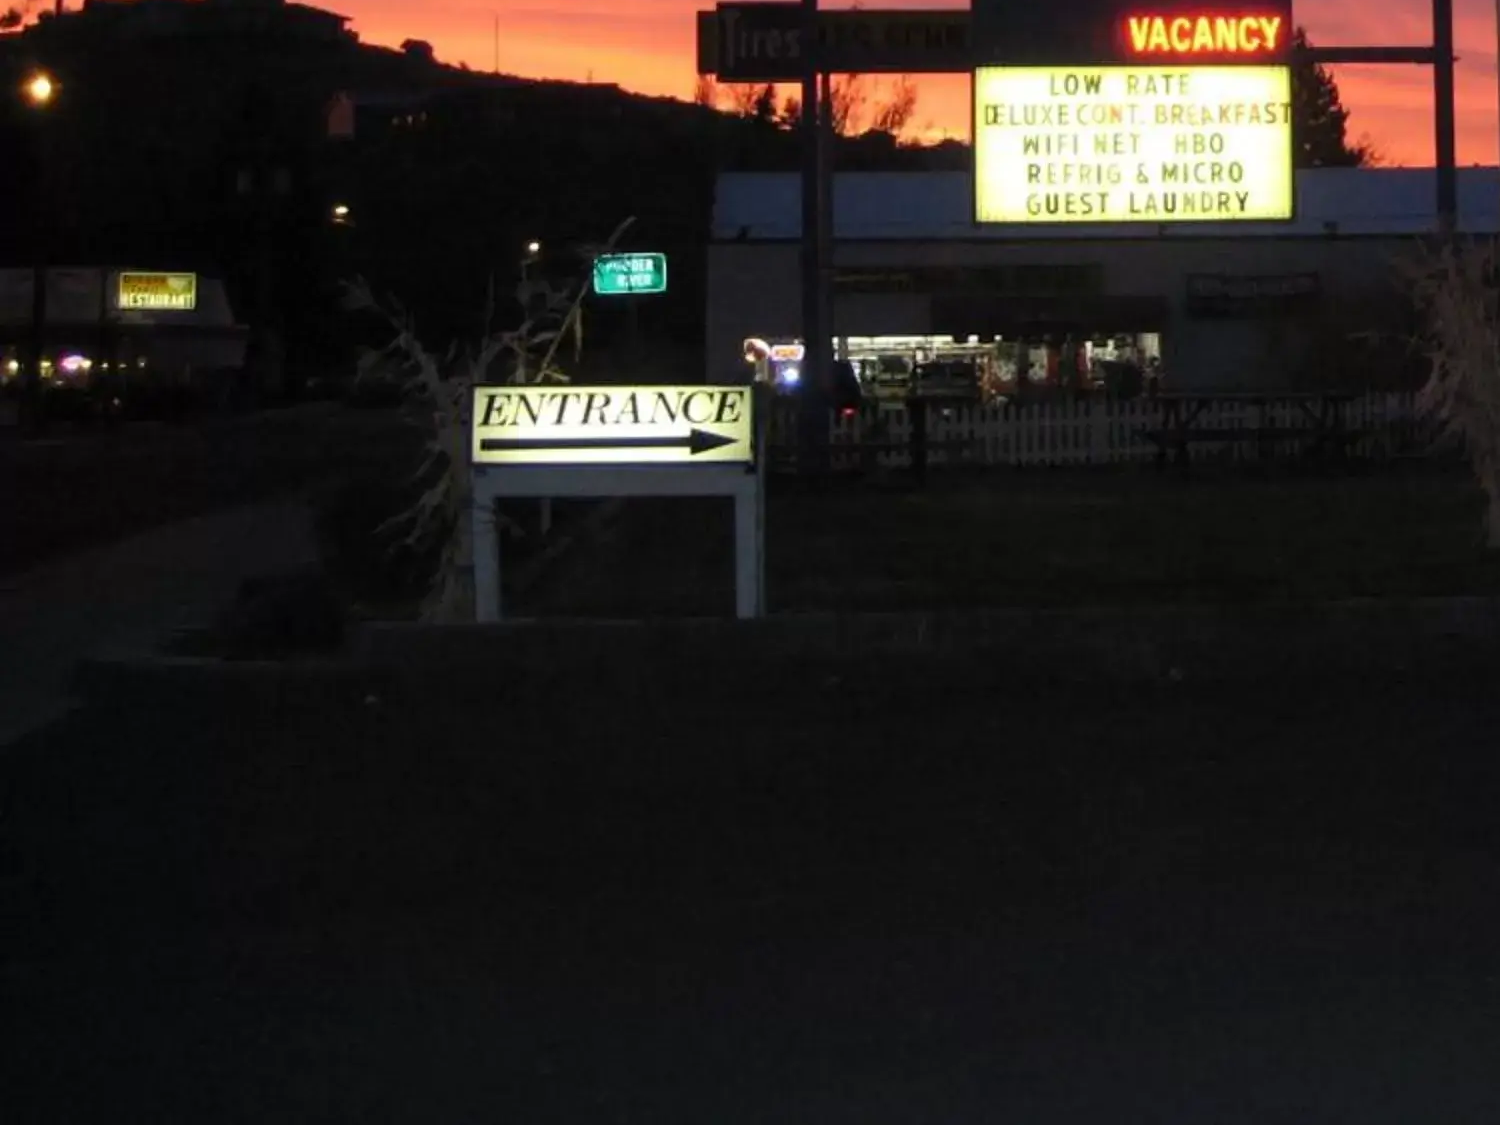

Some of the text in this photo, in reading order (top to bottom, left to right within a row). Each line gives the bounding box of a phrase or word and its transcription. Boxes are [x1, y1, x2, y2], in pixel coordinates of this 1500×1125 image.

[722, 9, 801, 69] Tires
[1128, 16, 1280, 52] VACANCY
[1050, 74, 1189, 96] LOW RATE
[1154, 103, 1291, 125] BREAKFAST
[1023, 132, 1224, 155] WIFI NET HBO
[1027, 162, 1243, 184] REFRIG & MICRO
[1026, 191, 1249, 215] GUEST LAUNDRY
[119, 294, 193, 308] RESTAURANT
[477, 390, 745, 426] ENTRANCE
